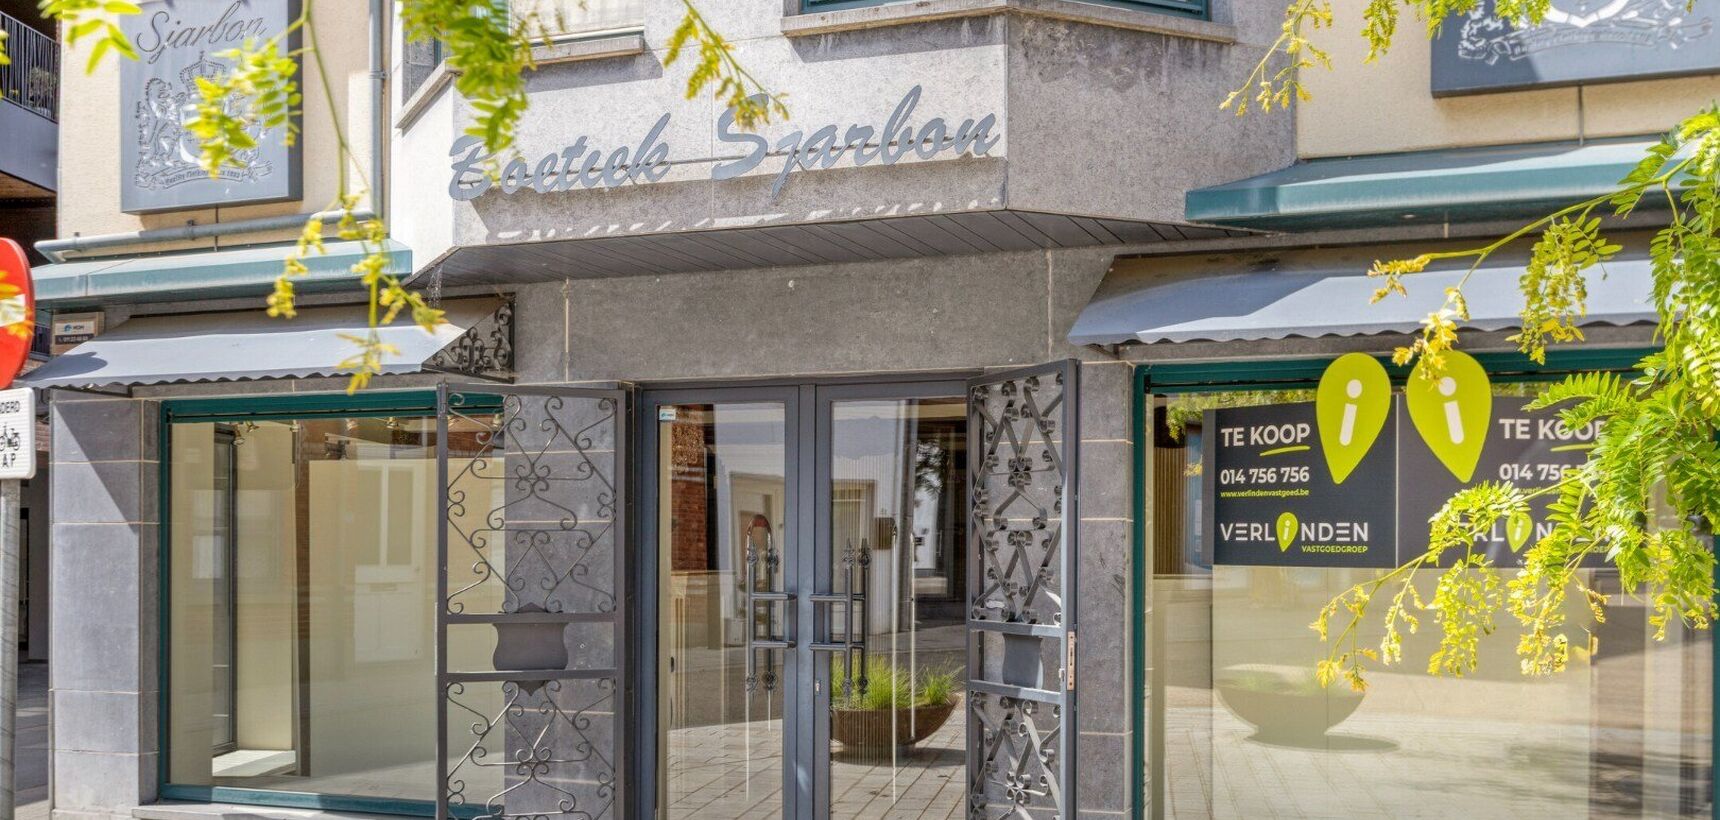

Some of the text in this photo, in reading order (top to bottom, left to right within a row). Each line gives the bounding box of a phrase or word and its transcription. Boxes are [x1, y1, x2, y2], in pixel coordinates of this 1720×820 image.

[136, 0, 268, 64] Sjarbon
[448, 84, 1001, 201] Boetiek Sjarbon
[1221, 423, 1311, 448] TE KOOP
[1499, 419, 1531, 440] TE
[1220, 466, 1311, 485] 014 756 756
[1499, 463, 1533, 481] 014
[1220, 488, 1310, 498] www.verlindenvastgoed.be
[1302, 545, 1369, 554] VASTGOEDGROEP
